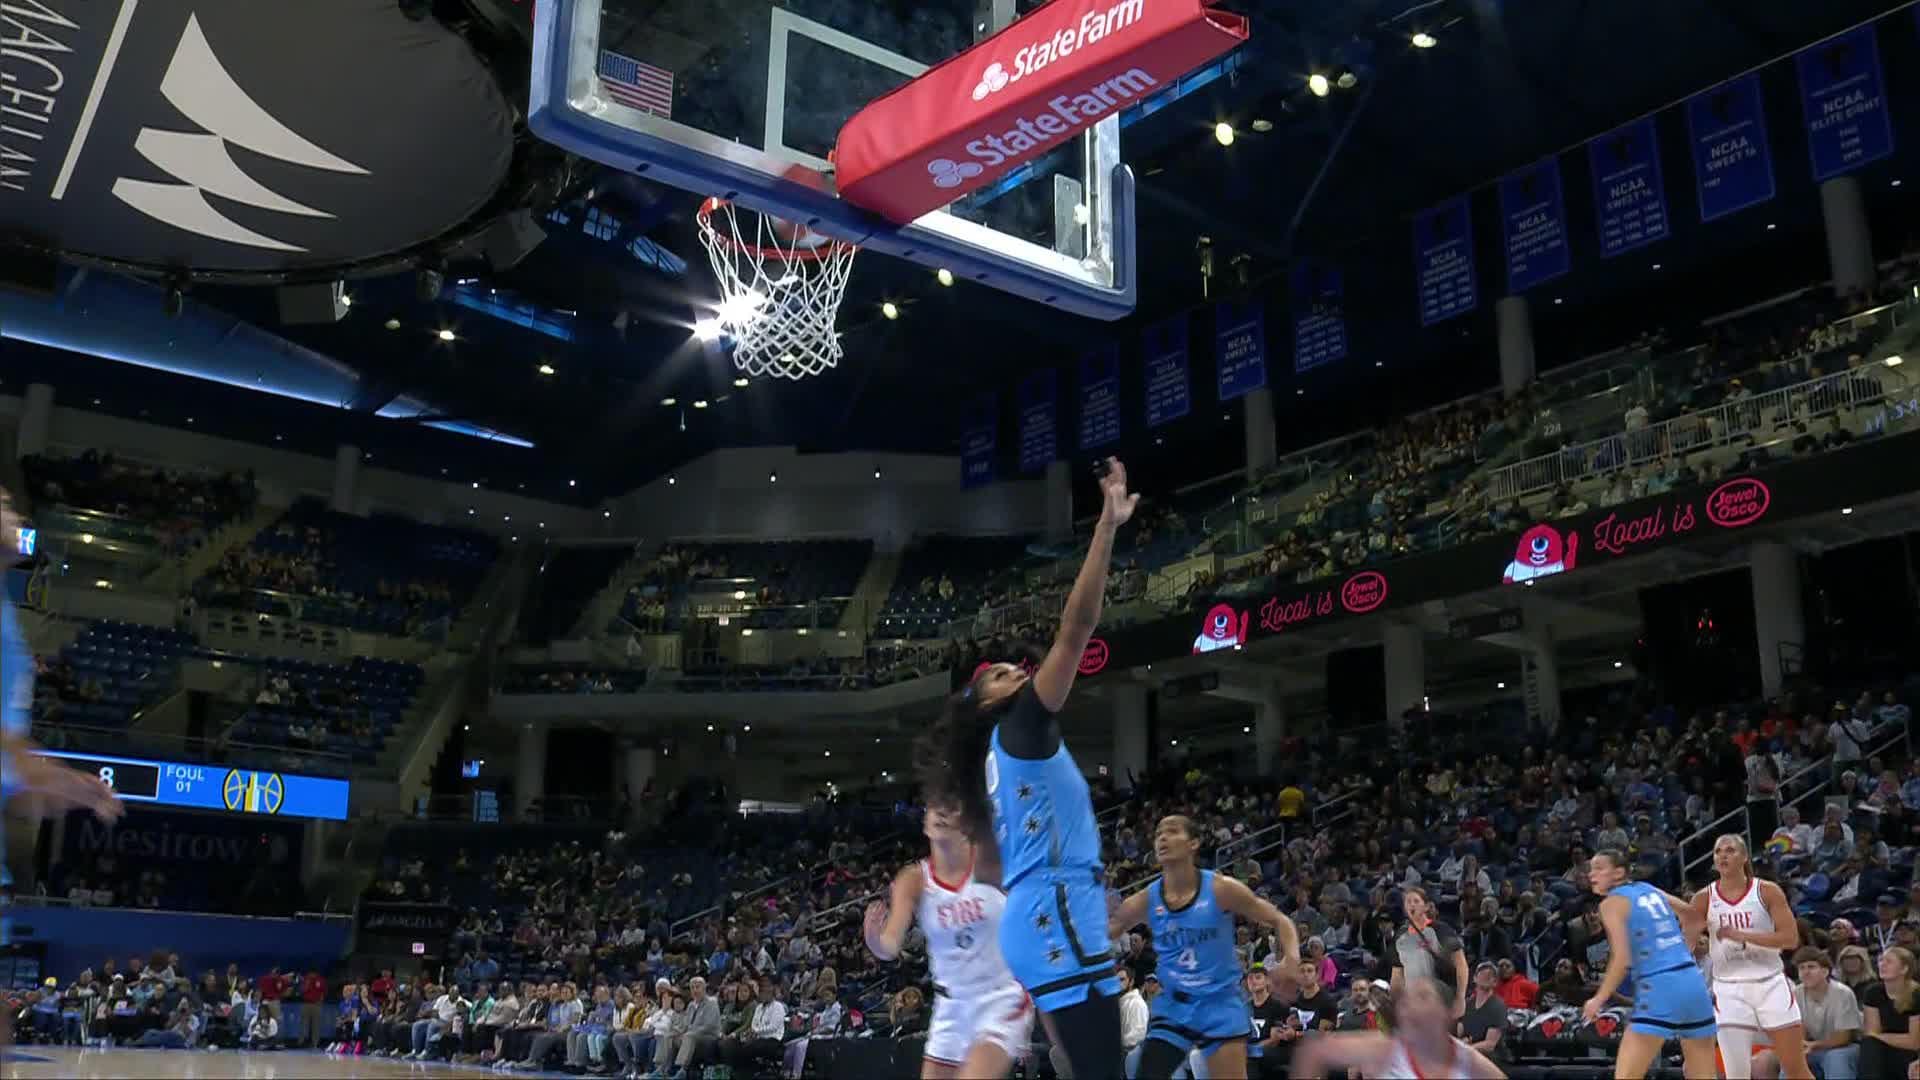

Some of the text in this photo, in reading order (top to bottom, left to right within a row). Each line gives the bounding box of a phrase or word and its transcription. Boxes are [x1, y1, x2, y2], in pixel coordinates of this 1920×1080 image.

[1823, 88, 1865, 114] NCAA
[1711, 136, 1751, 159] NCAA
[1704, 151, 1743, 172] SWEET
[1610, 176, 1646, 199] NCAA
[1518, 212, 1548, 232] NCAA
[1714, 486, 1758, 508] Jewel
[1717, 500, 1758, 521] Osco
[1594, 503, 1697, 555] Local is
[1260, 591, 1333, 633] Local is
[166, 765, 206, 782] FOUL
[175, 780, 192, 794] 01
[78, 818, 249, 864] Mesirow
[937, 897, 988, 929] FIRE
[1718, 911, 1755, 930] FIRE
[1178, 946, 1200, 970] 4
